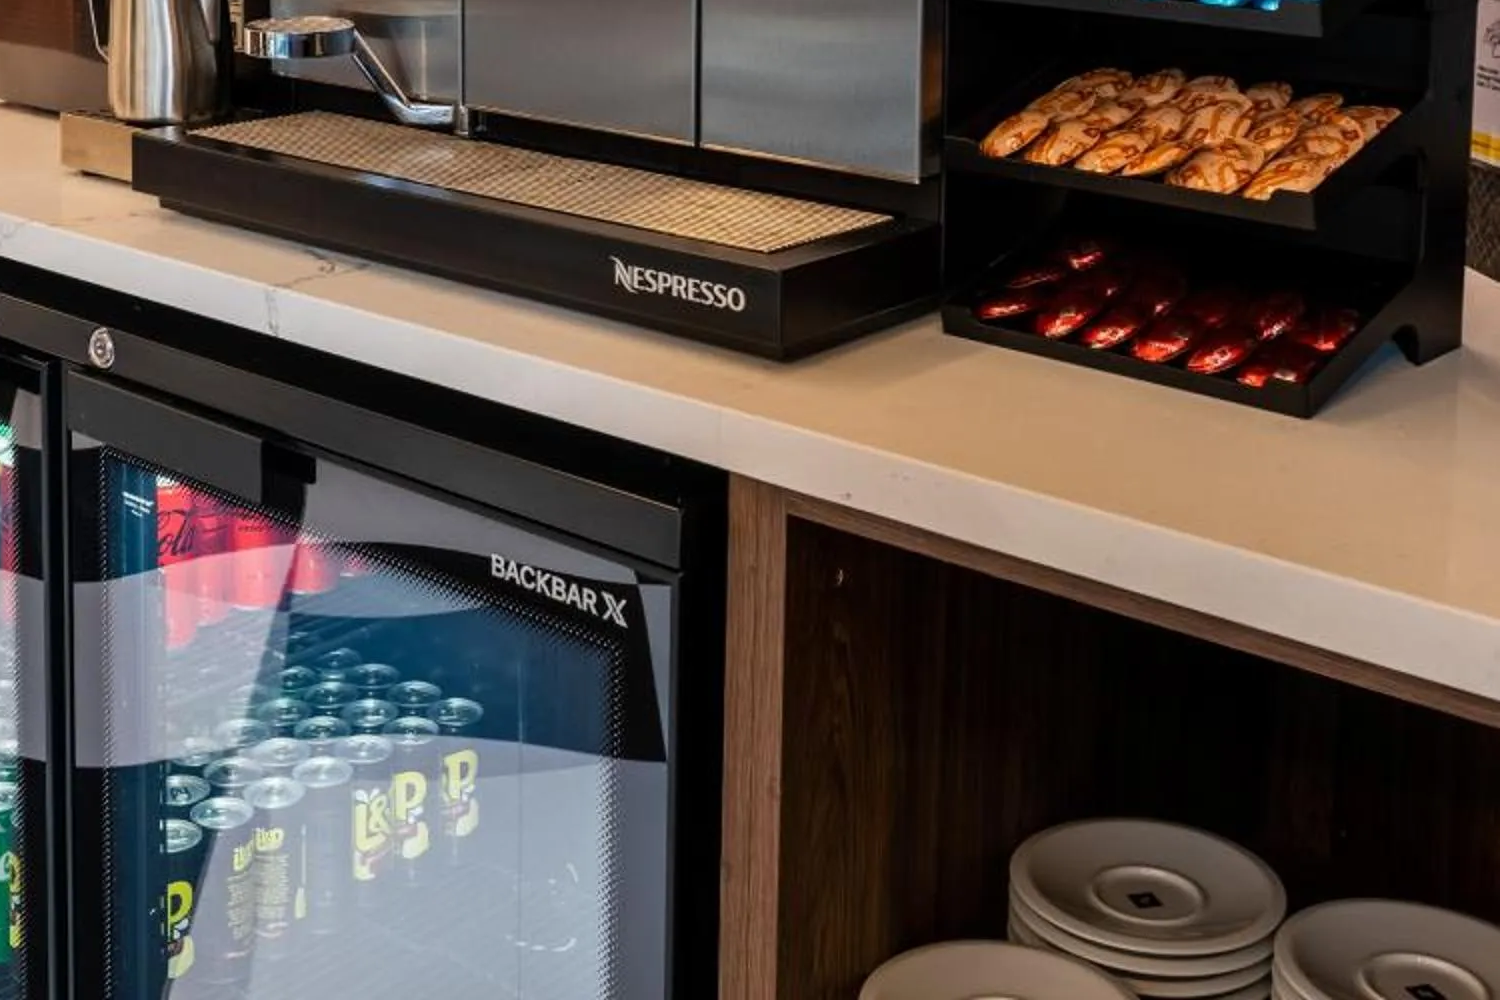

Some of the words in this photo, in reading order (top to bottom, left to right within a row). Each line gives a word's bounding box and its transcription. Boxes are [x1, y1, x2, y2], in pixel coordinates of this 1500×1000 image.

[609, 255, 746, 312] NESPRESSO
[490, 552, 599, 617] BACKBAR
[602, 590, 629, 629] X
